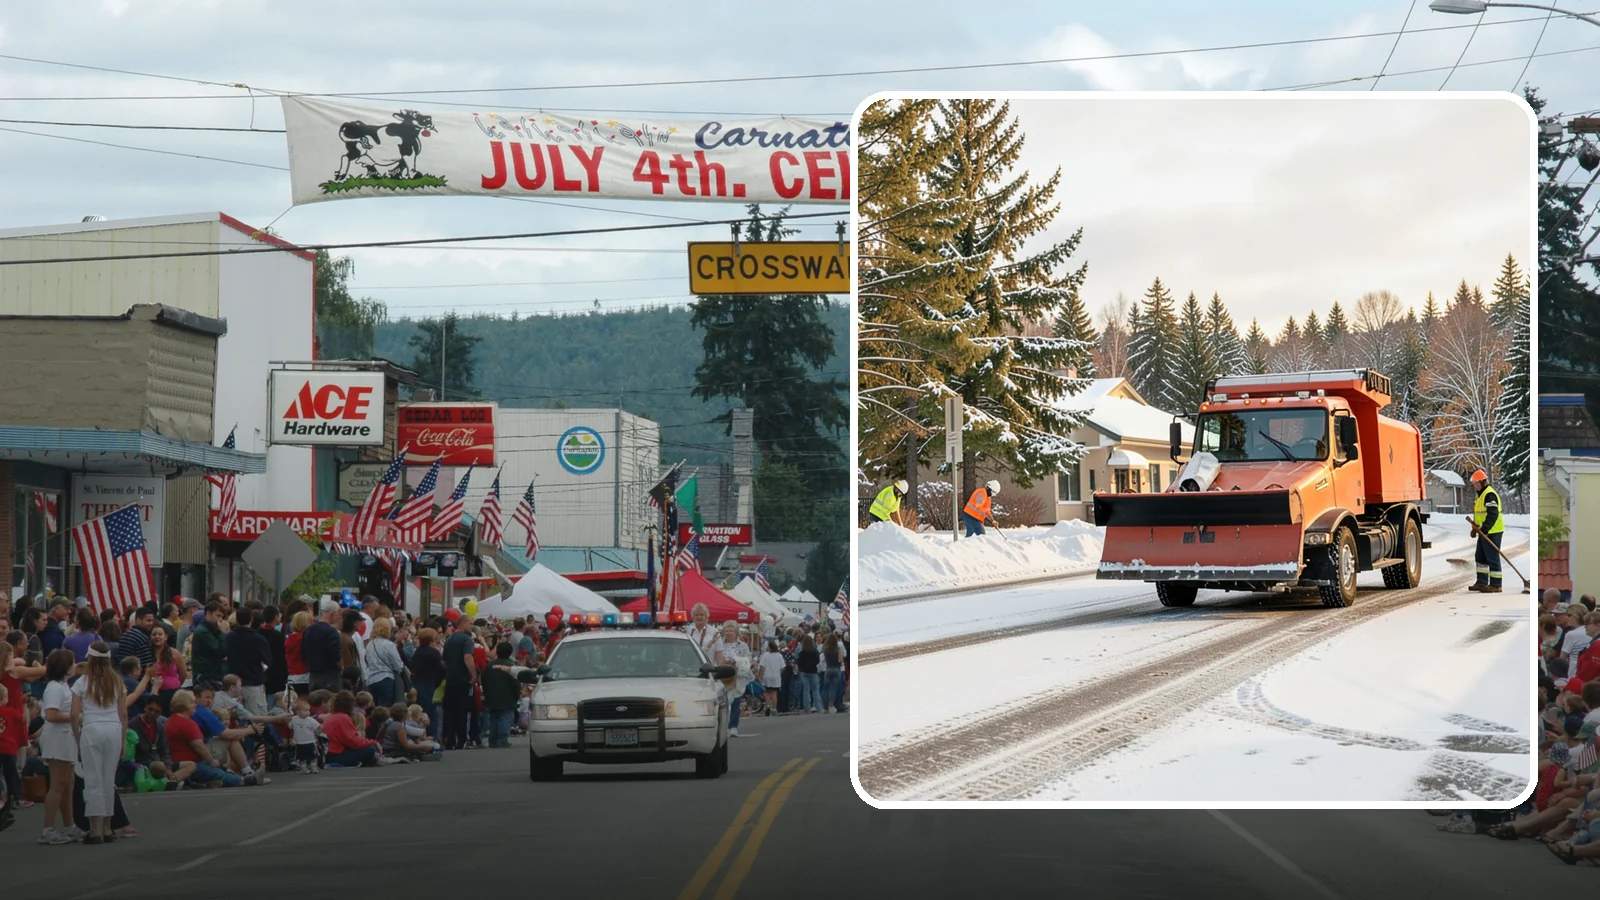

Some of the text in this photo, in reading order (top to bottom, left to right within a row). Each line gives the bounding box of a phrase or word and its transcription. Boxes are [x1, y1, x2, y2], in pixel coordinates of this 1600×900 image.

[481, 141, 605, 192] JULY
[632, 149, 746, 197] 4th.
[697, 254, 850, 280] CROSSWA
[282, 380, 373, 419] ACE
[405, 409, 452, 422] CEDAR
[283, 421, 371, 436] Hardware
[416, 428, 477, 447] Coca-Cola
[353, 467, 384, 483] Simpl
[83, 485, 155, 495] St. Vincent de Paul
[688, 526, 741, 535] CRNATION
[699, 535, 730, 543] GLASS
